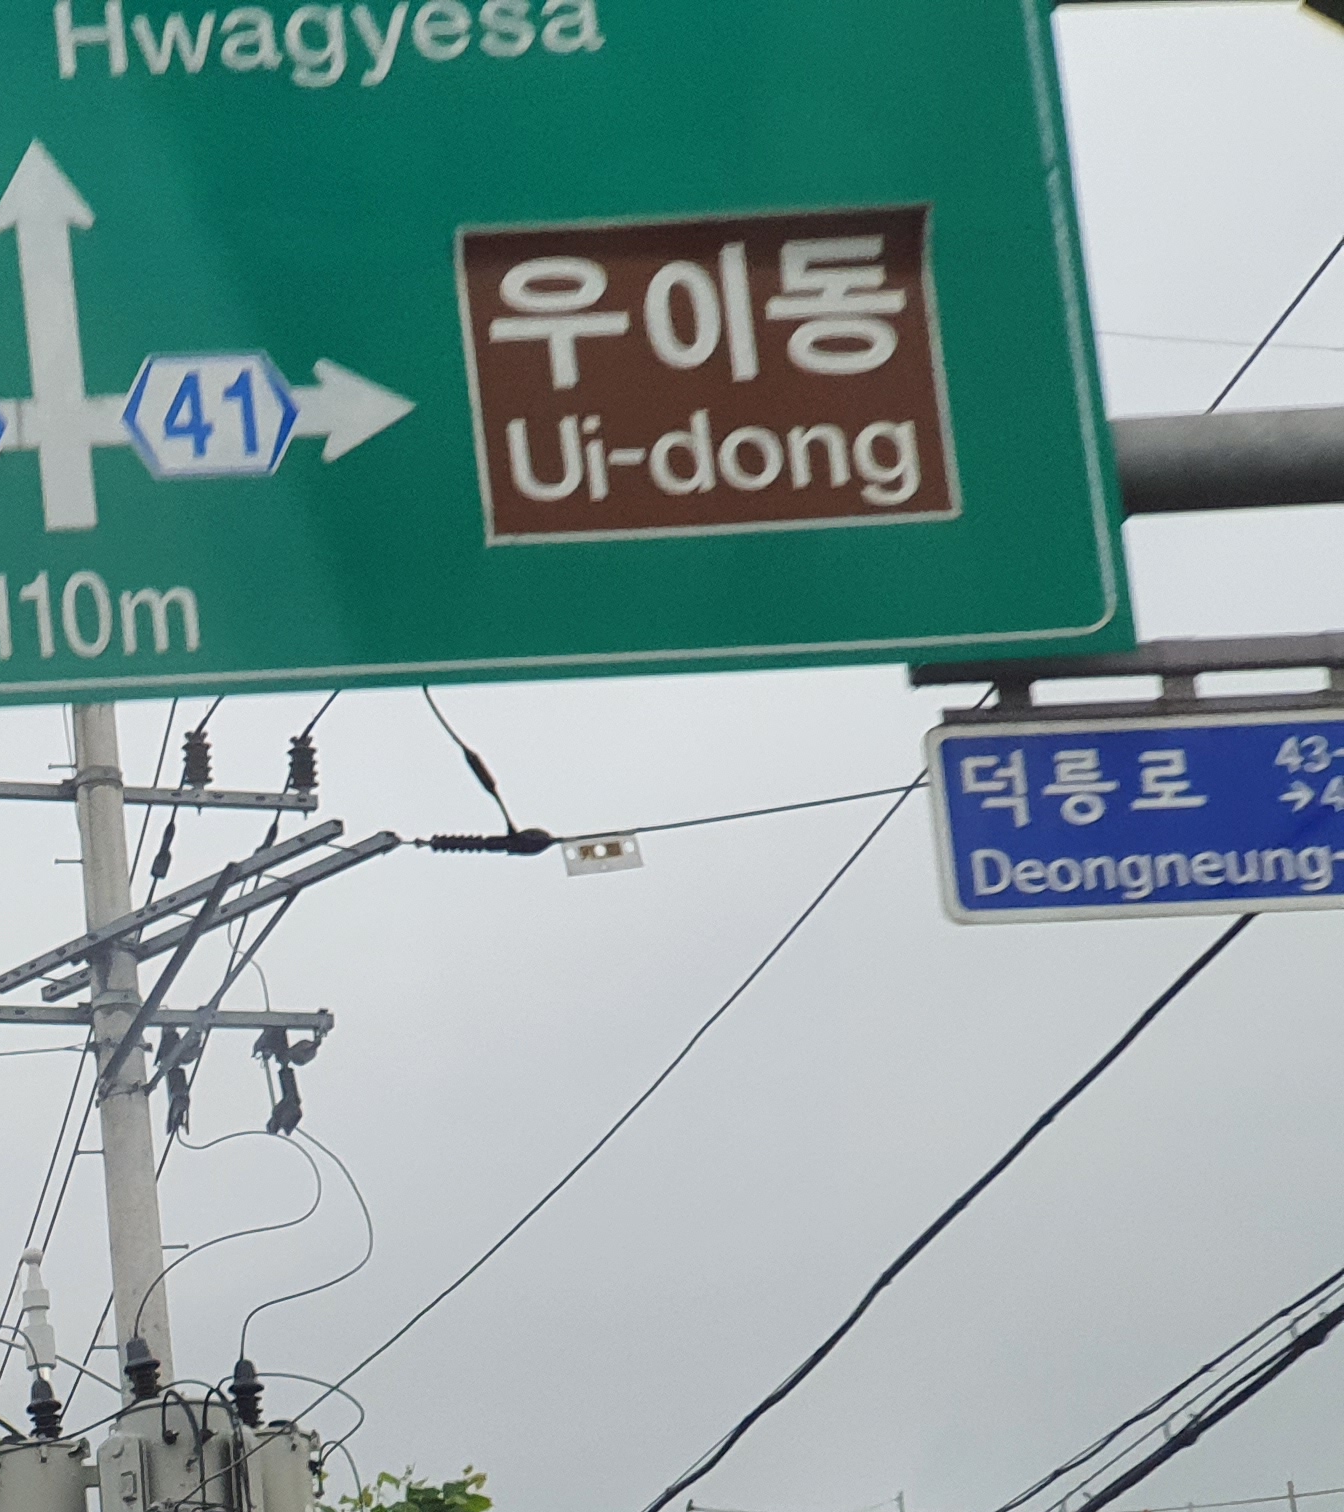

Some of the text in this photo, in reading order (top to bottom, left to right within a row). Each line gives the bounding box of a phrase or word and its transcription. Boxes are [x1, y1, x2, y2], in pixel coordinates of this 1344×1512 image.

[54, 0, 604, 87] Hwagyesa
[488, 234, 908, 392] 우이동
[160, 372, 265, 459] 41
[505, 410, 922, 505] Ui-dong
[959, 748, 1208, 829] 덕릉로
